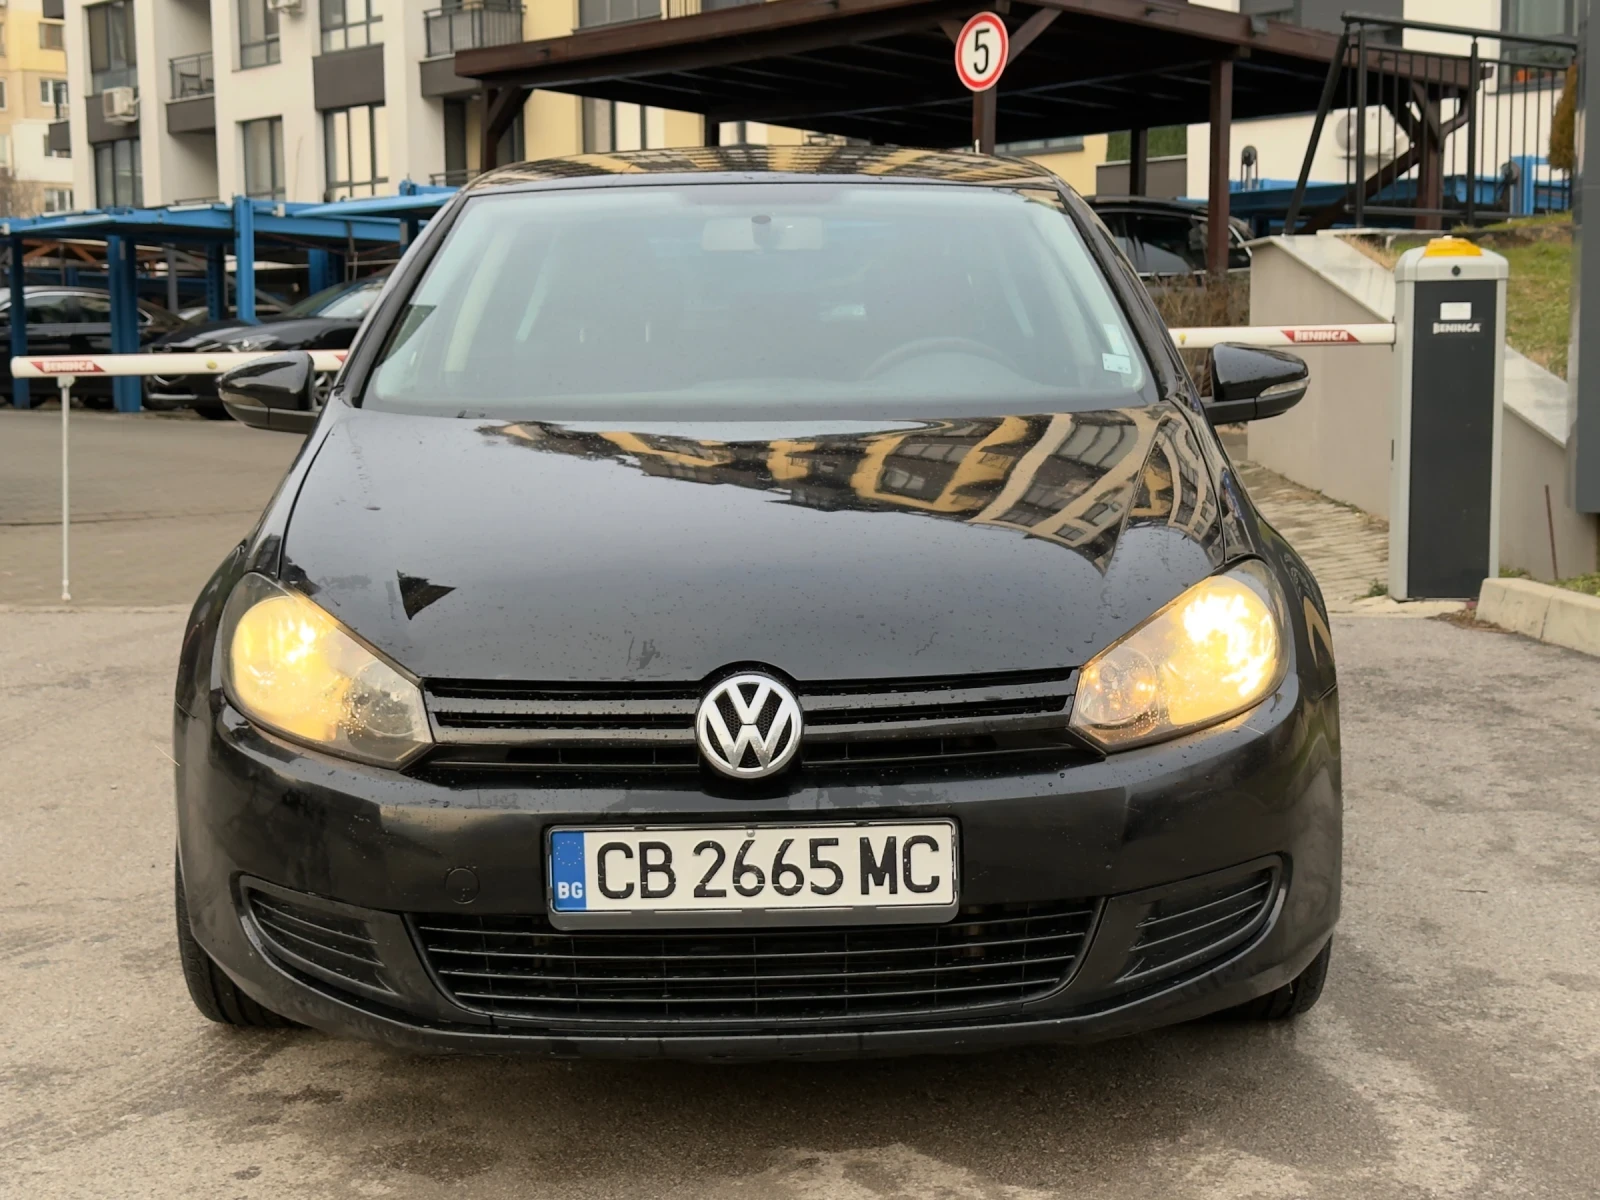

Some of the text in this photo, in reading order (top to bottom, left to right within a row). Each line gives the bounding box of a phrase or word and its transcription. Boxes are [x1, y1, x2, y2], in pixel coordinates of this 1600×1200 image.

[973, 28, 990, 75] 5
[697, 674, 802, 778] VW
[557, 881, 583, 899] BG
[597, 835, 940, 899] CB 2665 MC
